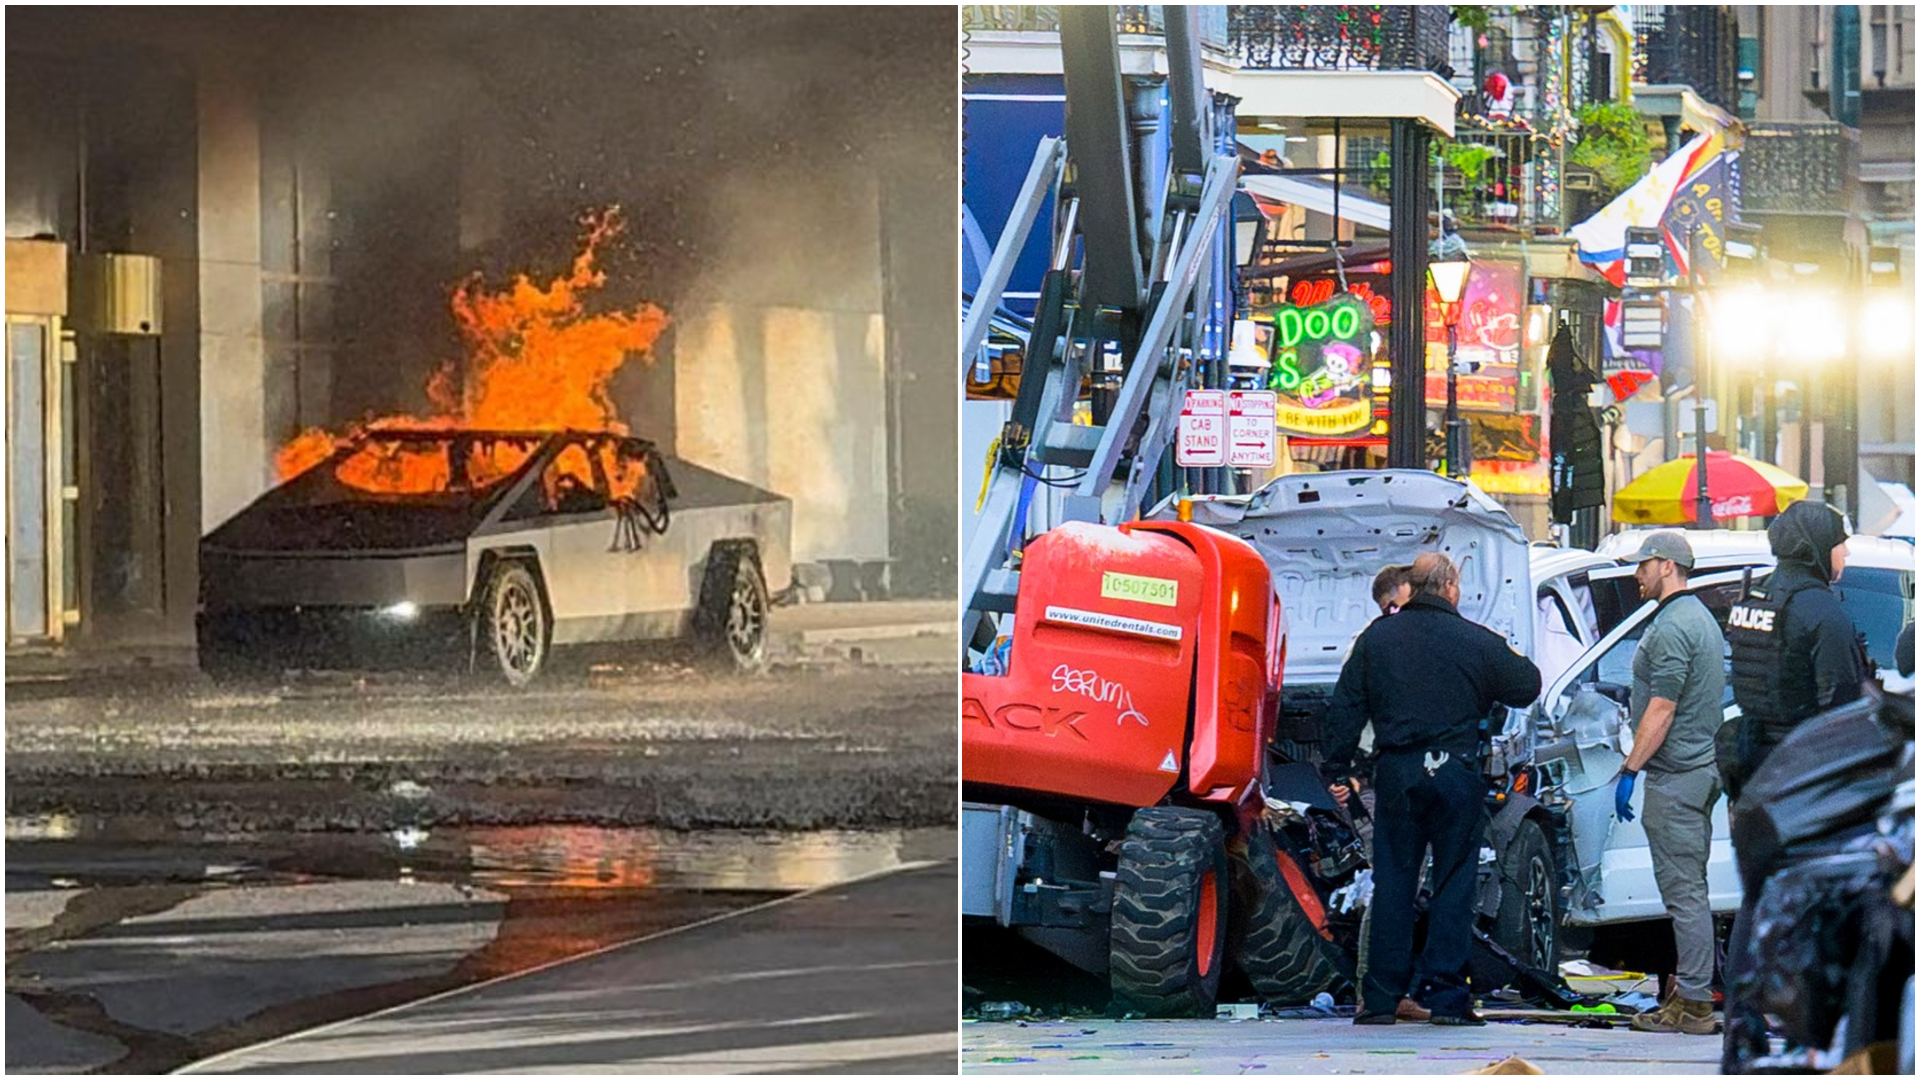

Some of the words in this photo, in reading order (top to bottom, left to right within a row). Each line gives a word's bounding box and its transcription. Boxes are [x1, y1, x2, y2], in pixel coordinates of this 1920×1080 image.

[1190, 418, 1212, 431] CAB
[1246, 418, 1258, 427] TO
[1286, 411, 1301, 426] BE
[1305, 414, 1337, 430] WITH
[1342, 408, 1363, 426] YOU
[1232, 429, 1270, 438] CORNER
[1184, 435, 1218, 447] STAND
[1231, 451, 1272, 462] ANYTIME
[1104, 577, 1175, 599] 10507501
[1048, 609, 1178, 637] www.unitedrentals.com
